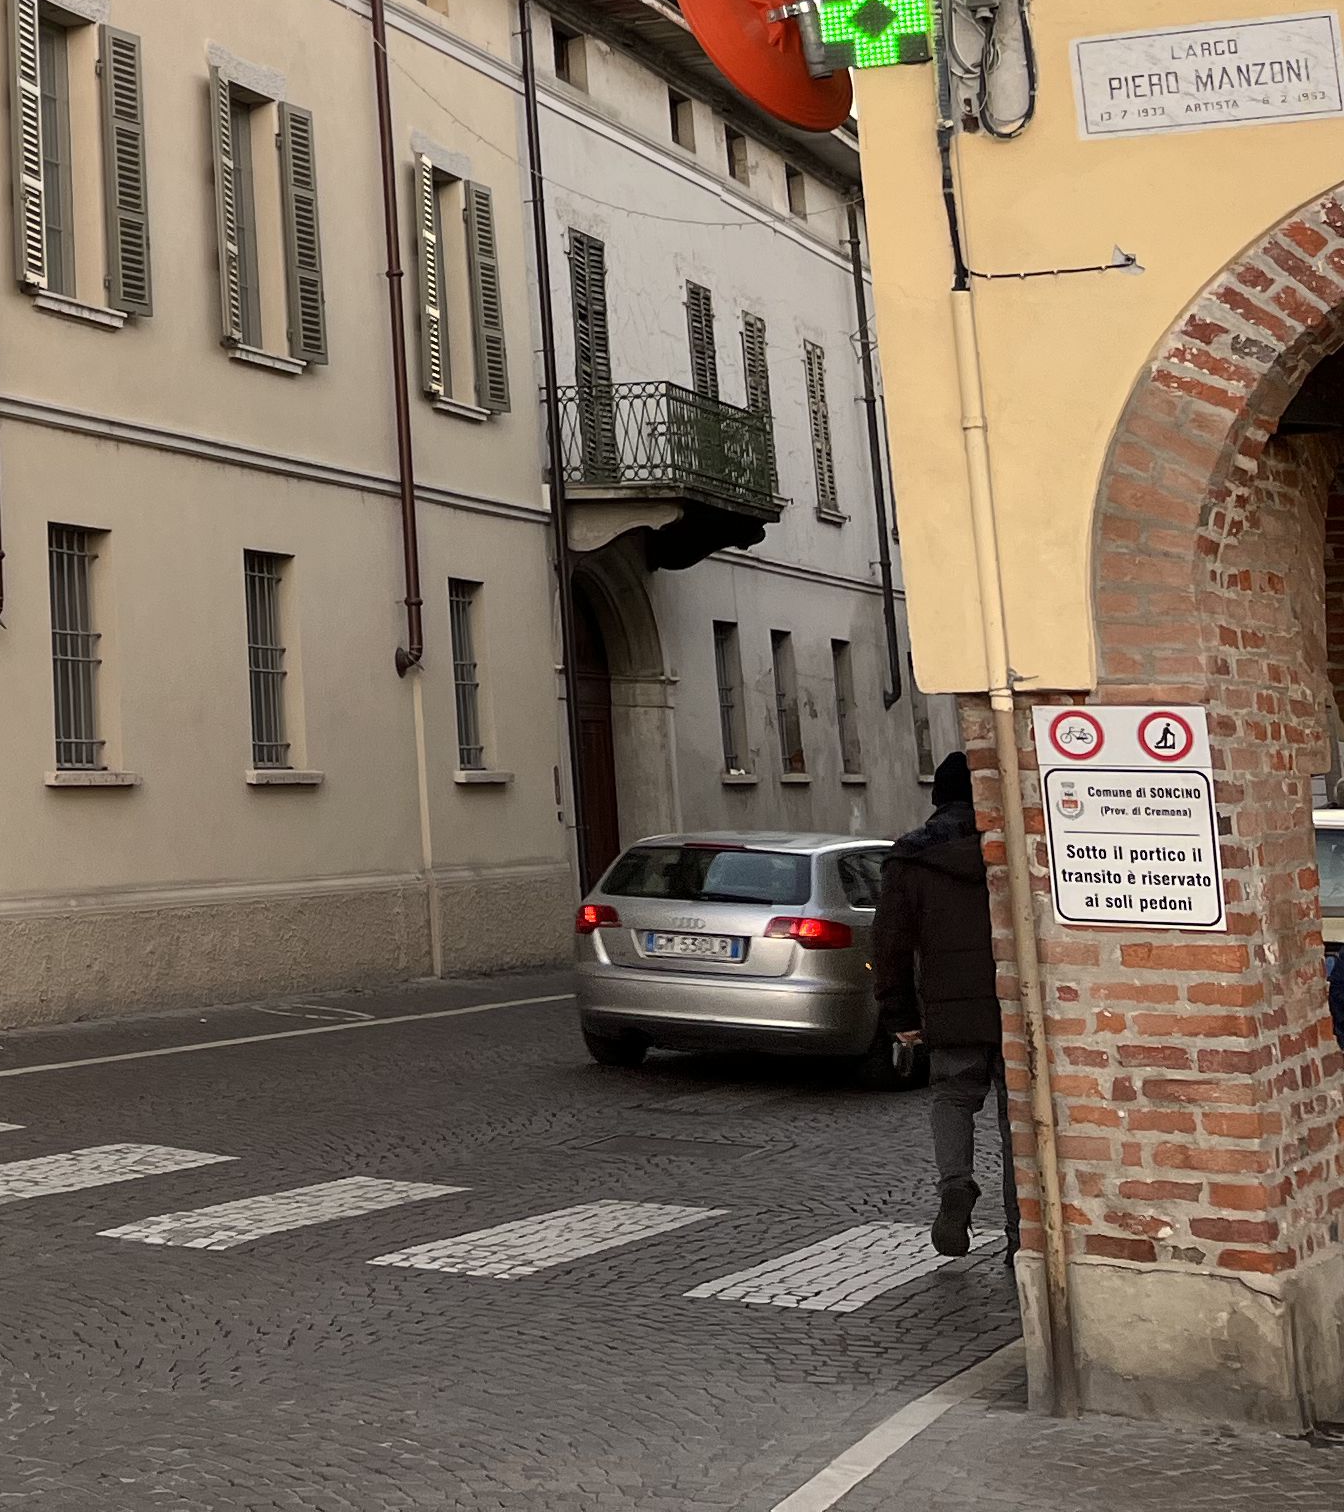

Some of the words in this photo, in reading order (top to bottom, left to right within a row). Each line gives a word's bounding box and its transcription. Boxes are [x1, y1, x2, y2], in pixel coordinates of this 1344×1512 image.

[1170, 39, 1239, 60] LARGO
[1108, 71, 1181, 100] PIERO
[1194, 58, 1311, 92] MANZONI
[1120, 110, 1128, 119] 7
[1137, 106, 1166, 117] 1933
[1184, 99, 1240, 114] ARTISTA
[1087, 786, 1133, 799] Comune
[1136, 787, 1147, 799] di
[1150, 787, 1201, 800] SONCINO
[1100, 806, 1129, 817] (Prov.
[1132, 806, 1142, 816] di
[1144, 806, 1193, 818] Cremona)
[1066, 844, 1107, 860] Sotto
[1114, 845, 1123, 860] il
[1130, 846, 1186, 864] portico
[1193, 847, 1202, 862] il
[1062, 869, 1122, 885] transito
[1127, 870, 1136, 885] è
[1142, 871, 1211, 887] riservato
[1085, 894, 1100, 908] ai
[1106, 895, 1133, 909] soli
[1140, 896, 1193, 912] pedoni
